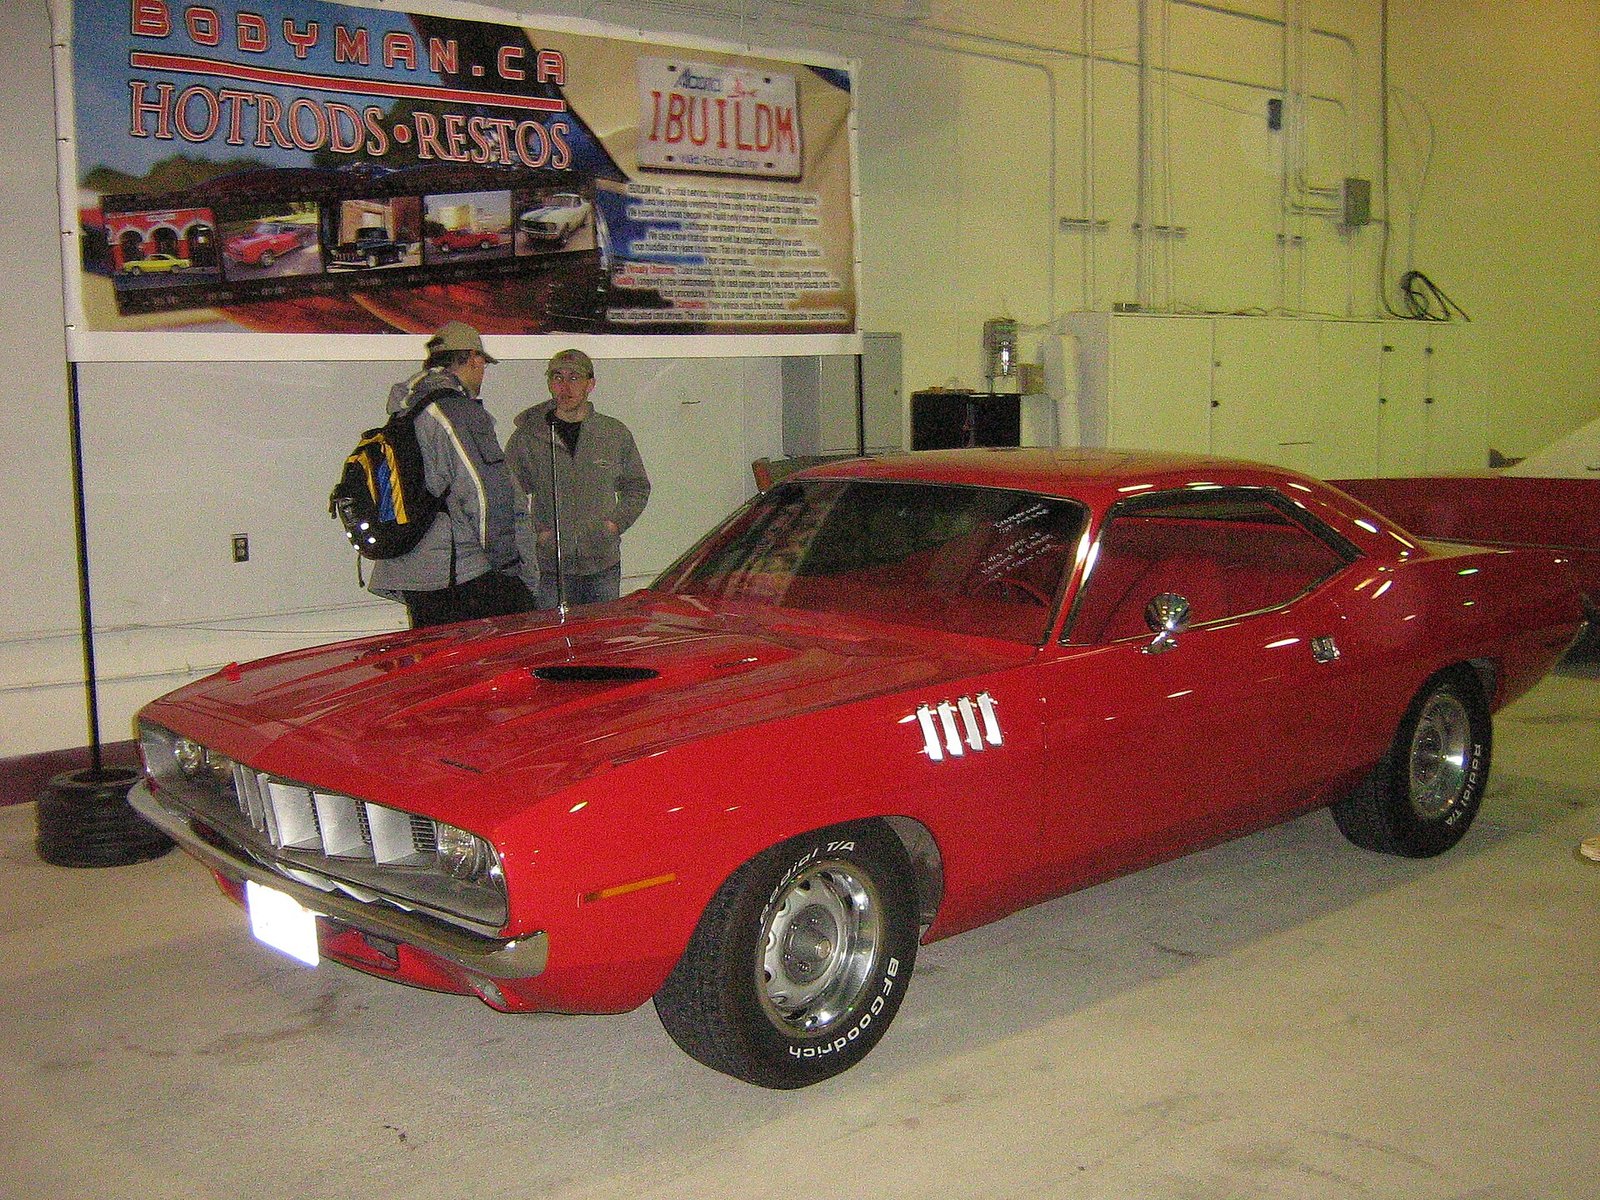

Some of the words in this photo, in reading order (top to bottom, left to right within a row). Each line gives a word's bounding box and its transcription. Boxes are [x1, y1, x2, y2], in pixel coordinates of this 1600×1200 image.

[131, 0, 566, 85] BODYMAN.CA
[130, 81, 388, 156] HOTRODS
[412, 111, 571, 169] RESTOS
[648, 90, 797, 153] IBUILDM
[826, 840, 855, 852] T/A
[789, 957, 899, 1059] BFGoodrich
